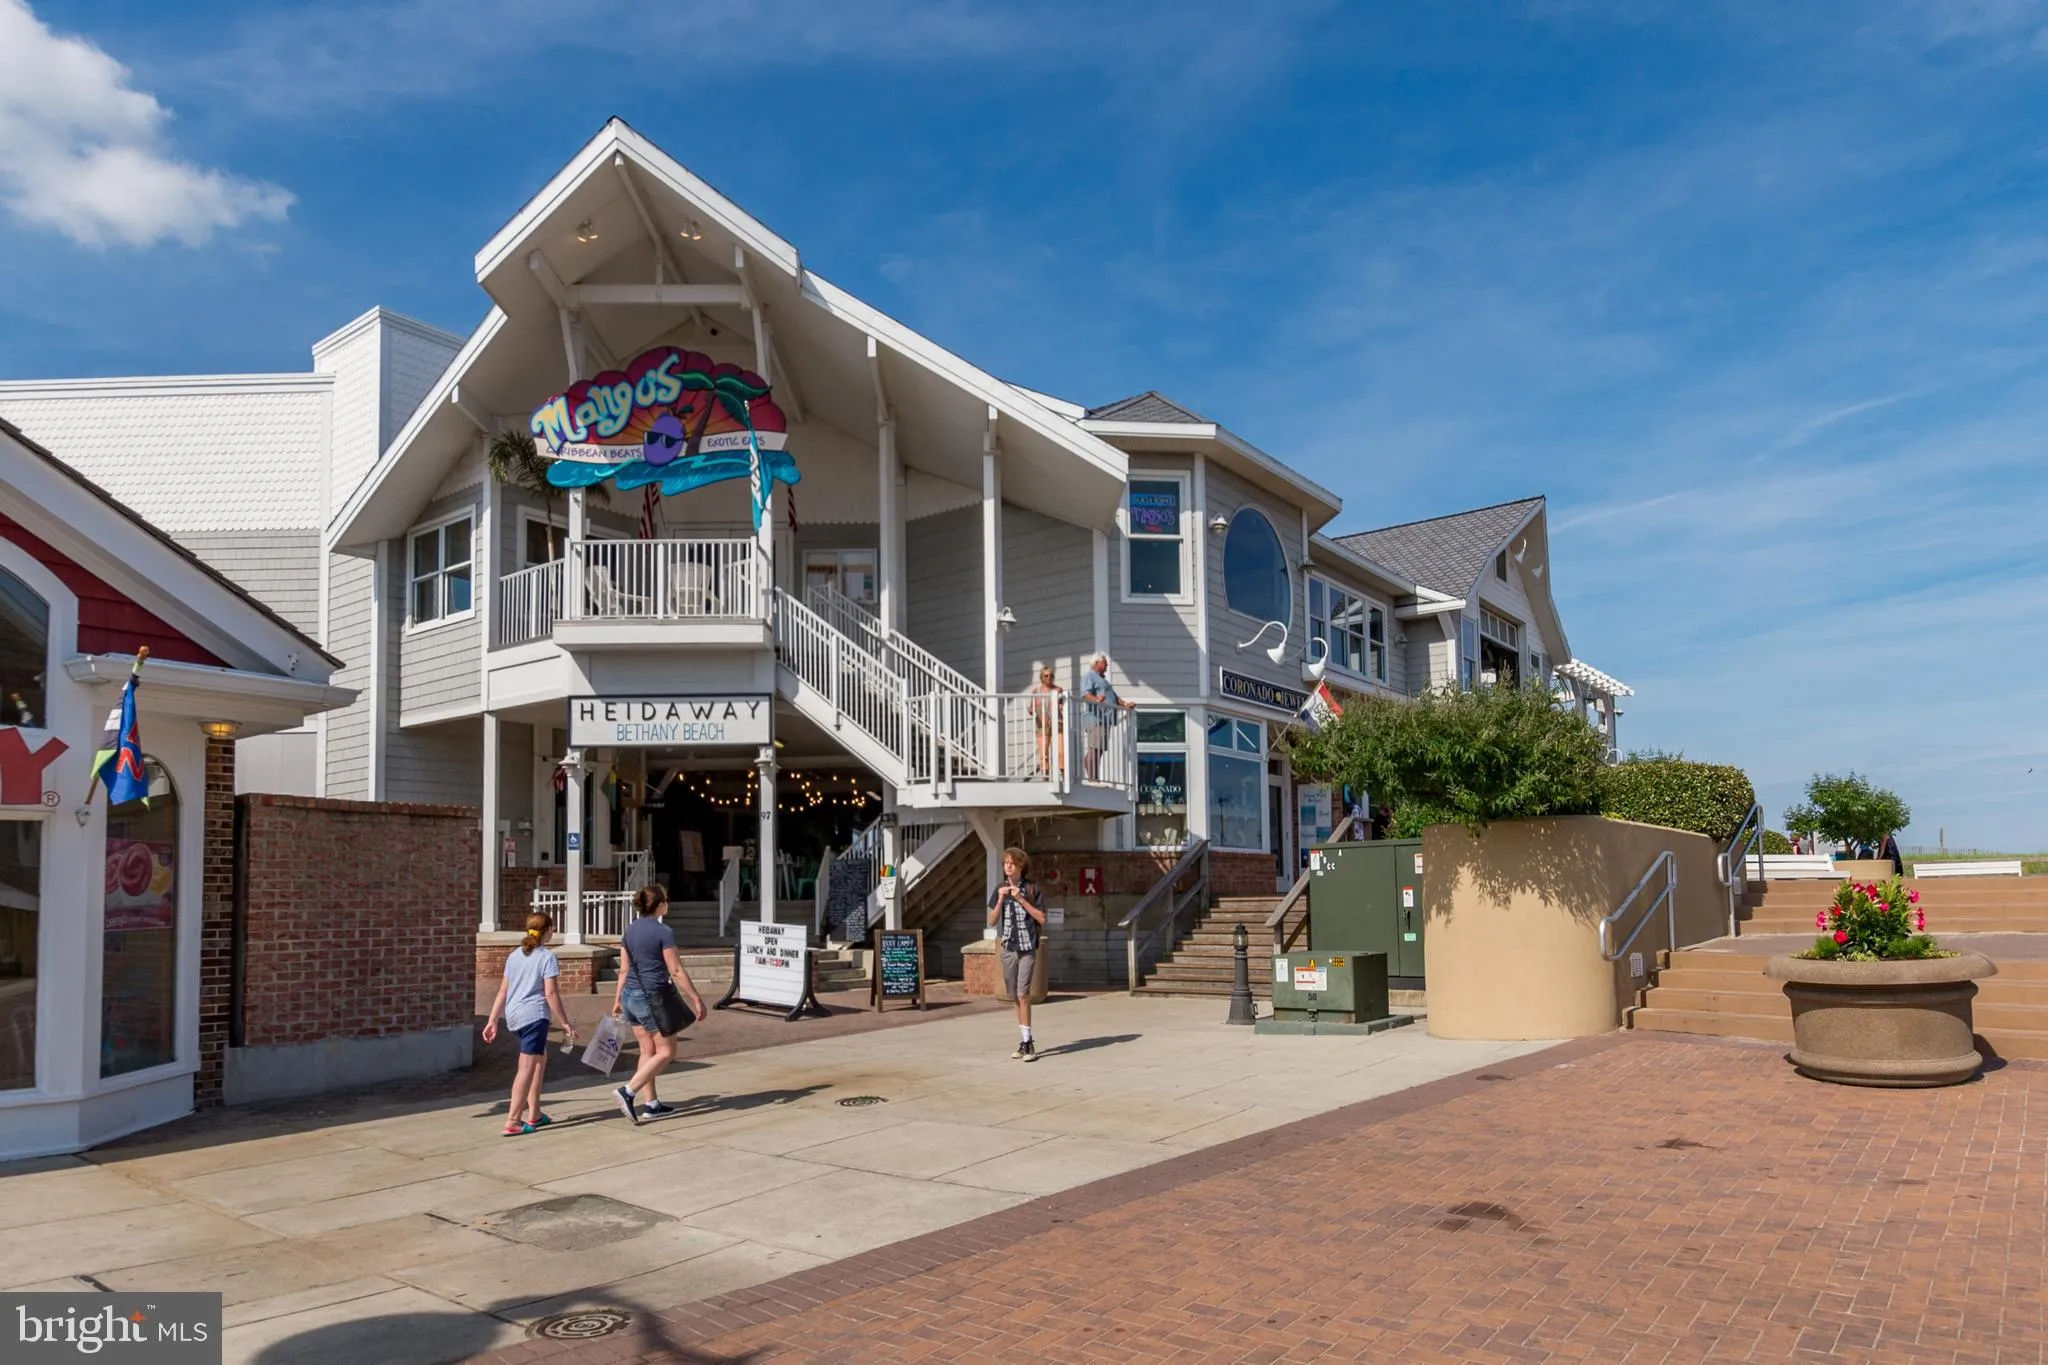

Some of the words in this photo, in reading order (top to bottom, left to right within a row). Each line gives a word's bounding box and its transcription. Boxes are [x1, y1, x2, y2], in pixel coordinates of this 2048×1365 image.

[707, 436, 739, 448] EXOTIC
[609, 447, 643, 458] BEATS
[1223, 675, 1274, 703] CORONADO
[580, 701, 761, 721] HEIDAWAY
[616, 724, 679, 741] BETHANY
[683, 723, 725, 741] BEACH
[764, 936, 778, 945] OPEN
[746, 945, 764, 955] LUNCH
[766, 947, 777, 956] AND
[779, 948, 799, 959] DINNER
[1308, 992, 1317, 1001] 50
